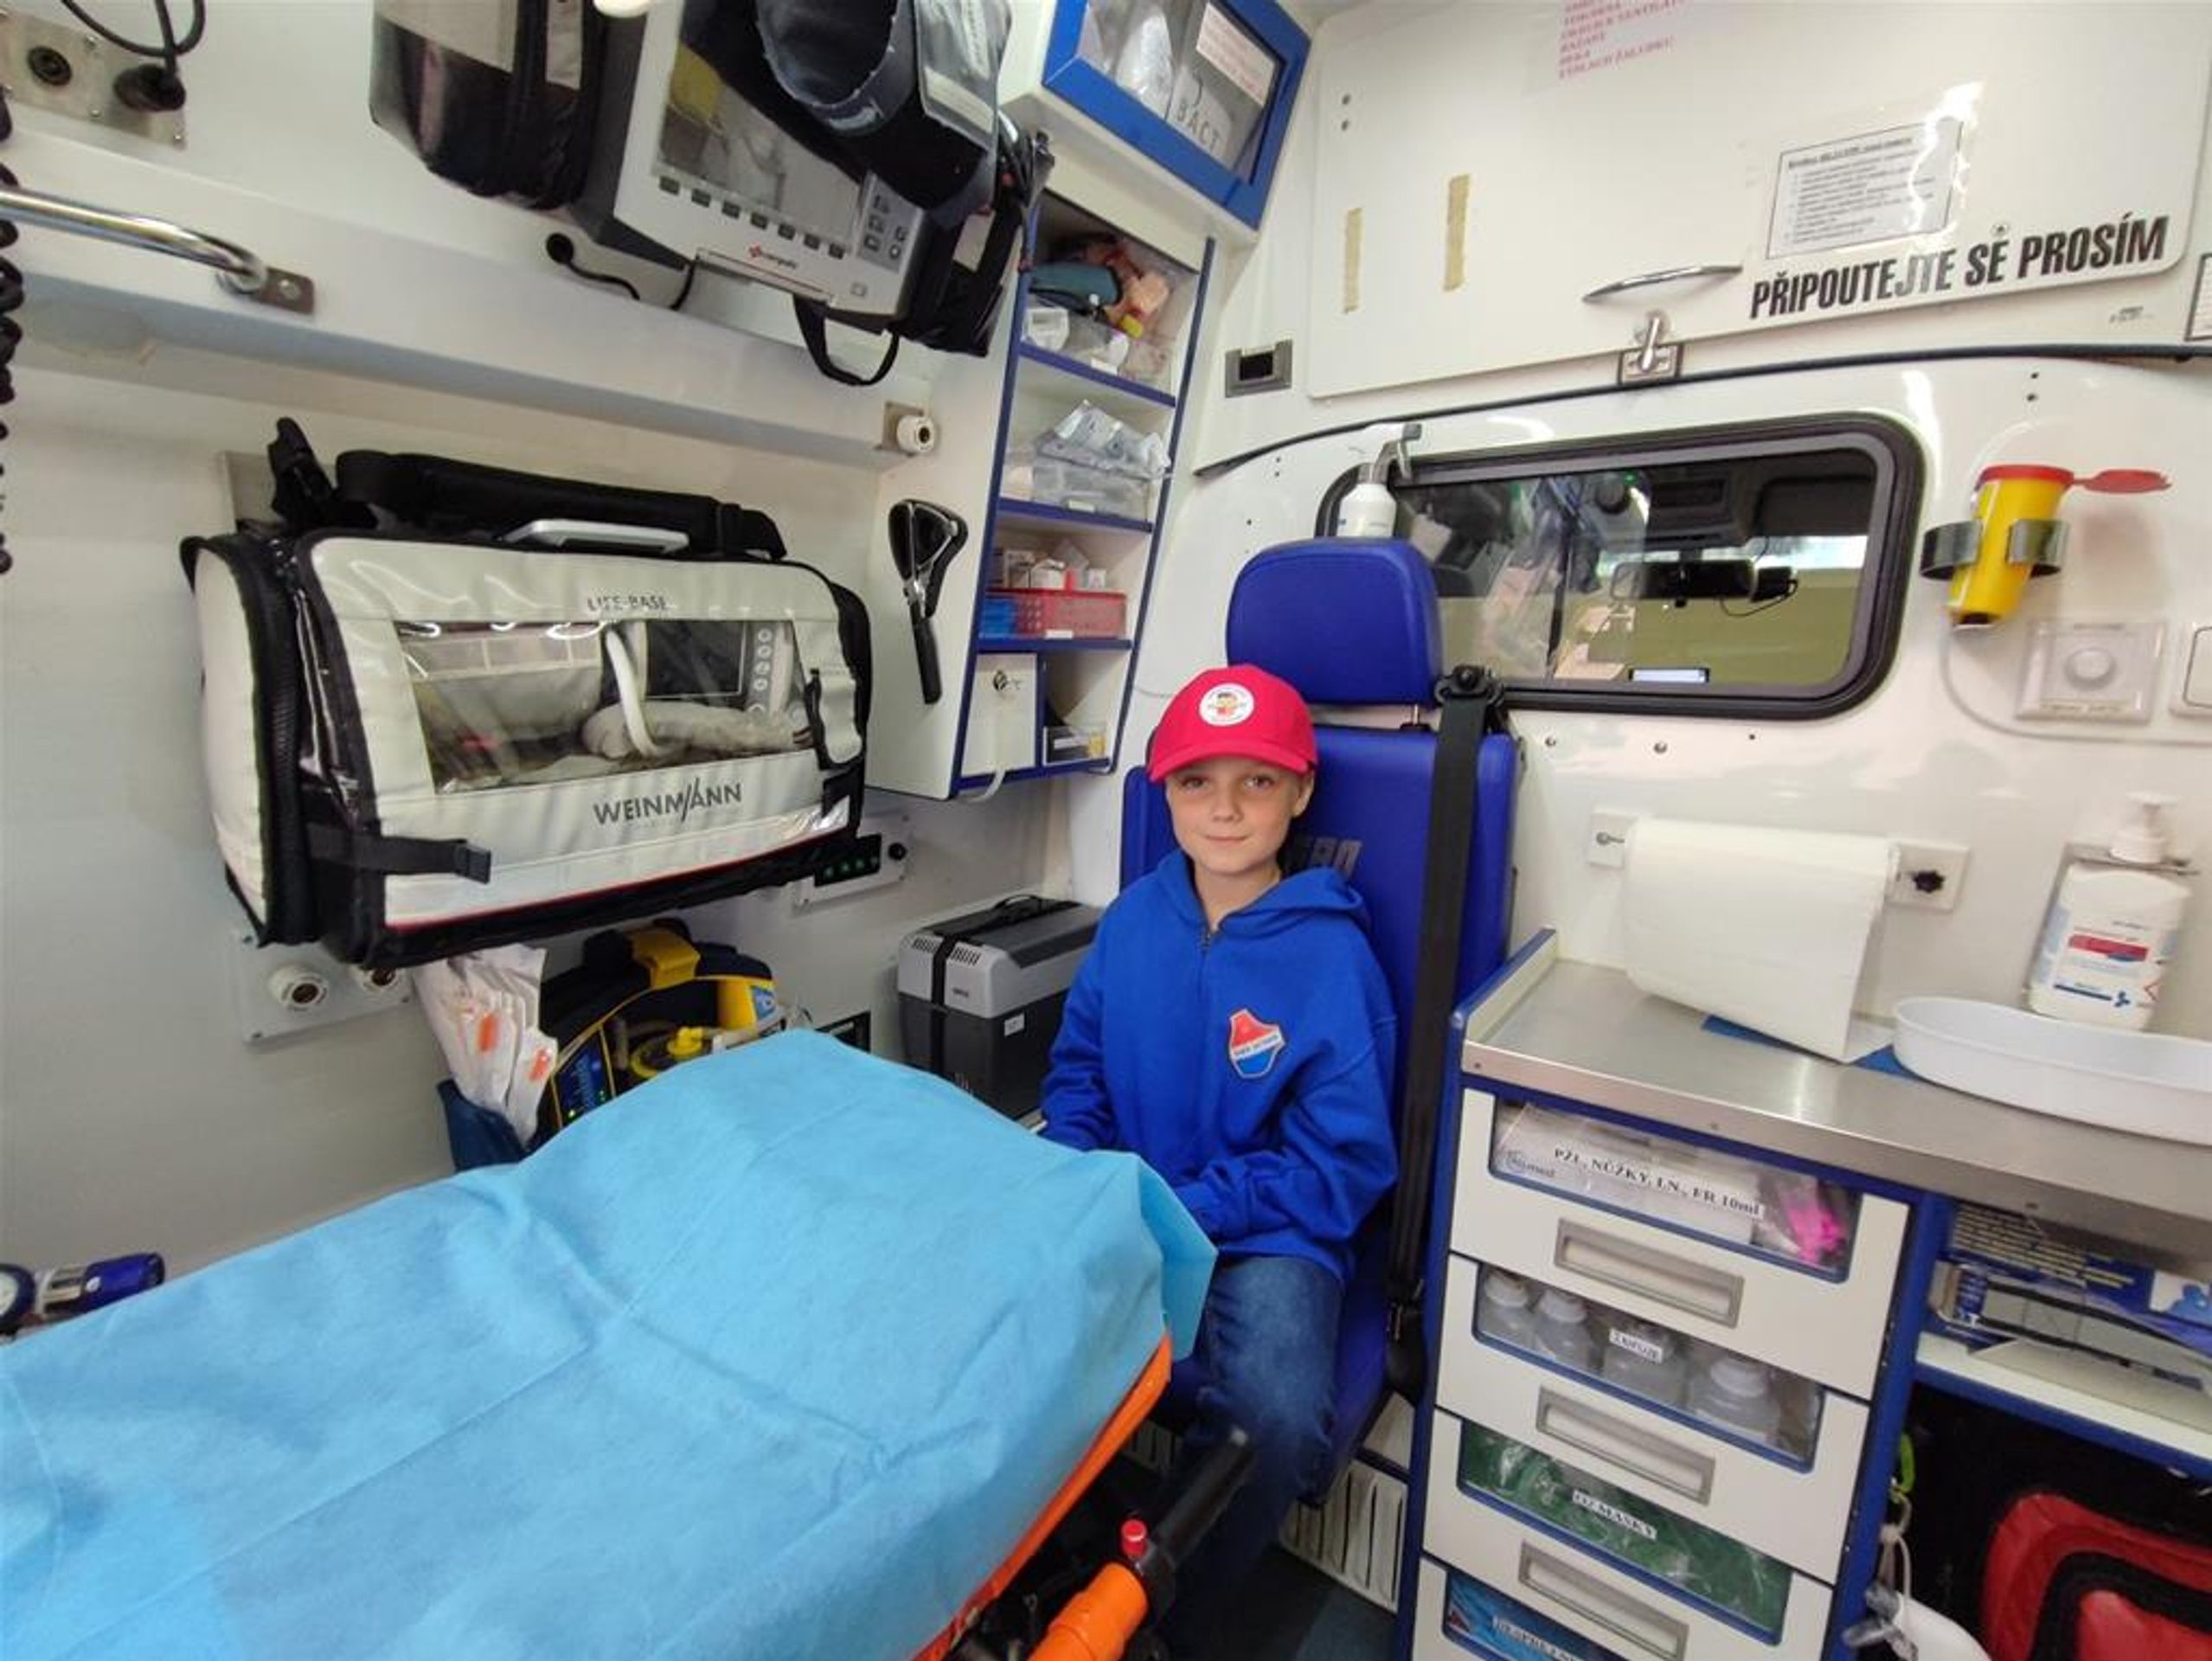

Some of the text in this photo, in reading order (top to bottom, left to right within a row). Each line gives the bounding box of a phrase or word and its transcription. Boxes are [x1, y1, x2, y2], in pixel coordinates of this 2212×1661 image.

[1749, 211, 2170, 319] PŘIPOUTEJTE SE PROSÍM
